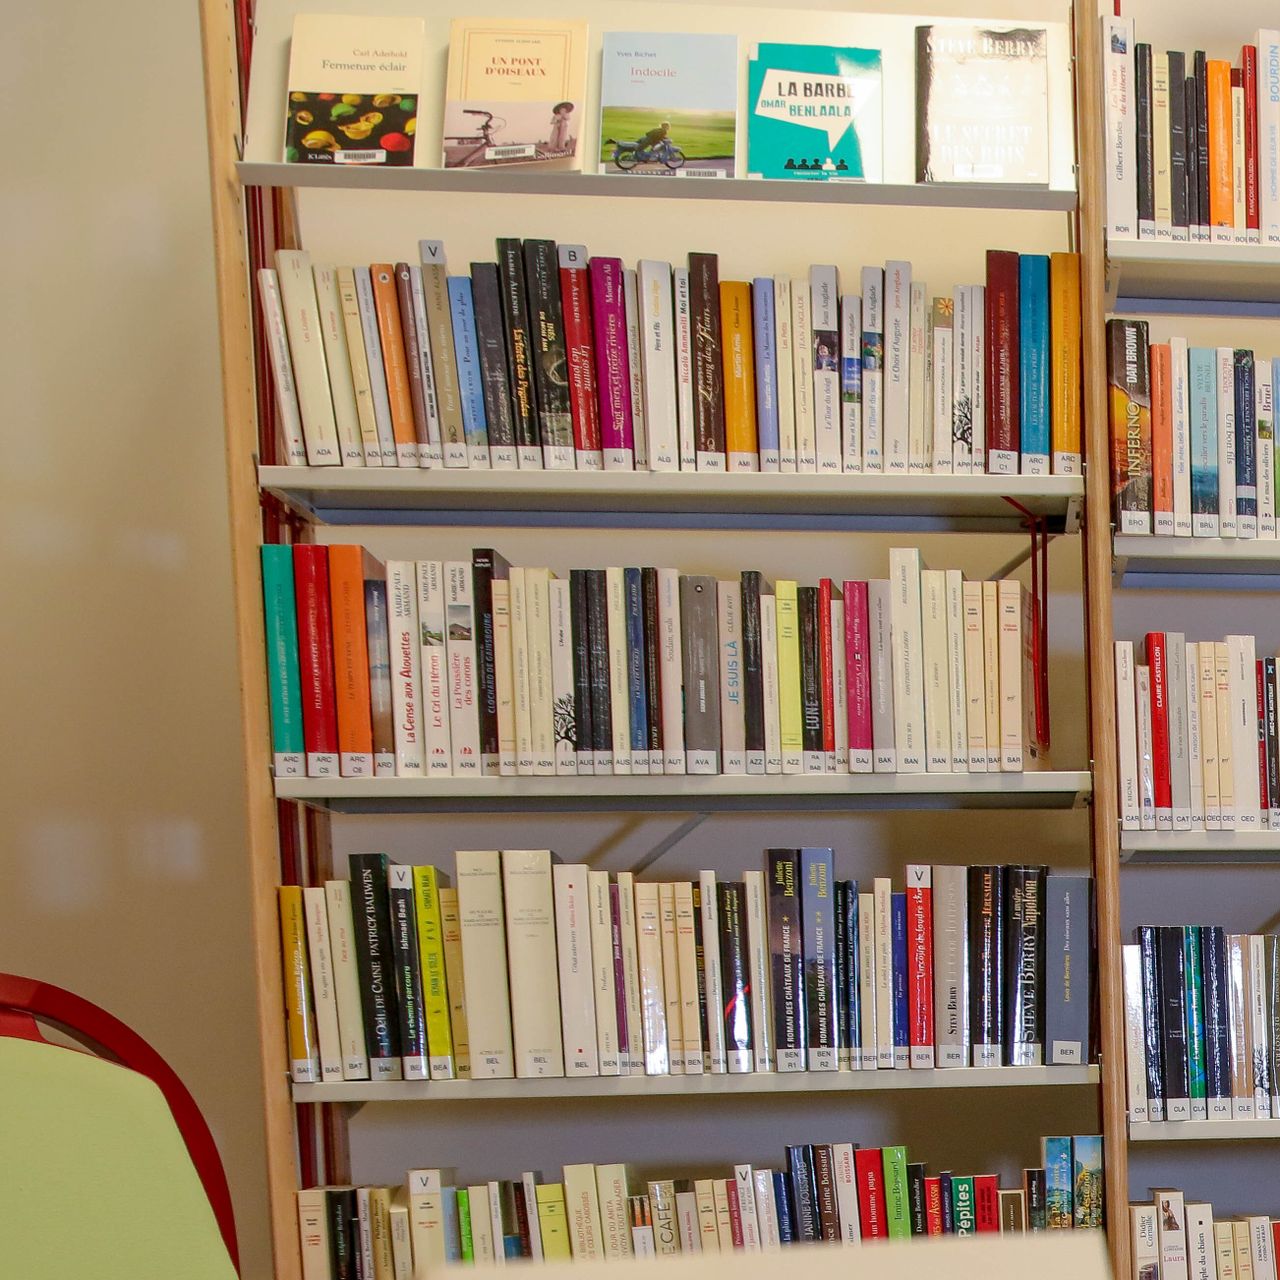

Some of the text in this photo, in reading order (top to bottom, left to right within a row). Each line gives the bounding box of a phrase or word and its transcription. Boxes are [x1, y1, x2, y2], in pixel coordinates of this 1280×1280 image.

[322, 60, 406, 71] Fermeture éclair
[492, 57, 542, 66] UN PONT
[485, 67, 546, 77] D'OISEAUX
[630, 67, 677, 77] Indocile
[1270, 44, 1280, 103] BOURDIN
[778, 82, 856, 98] LA BARBE
[761, 100, 786, 109] OMAR
[789, 104, 851, 117] BENLAALA
[1126, 328, 1137, 383] DAN BROWN
[1128, 402, 1141, 477] INFERNO
[453, 652, 461, 709] La Poussière
[730, 640, 740, 705] JE SUIS LÀ
[401, 632, 415, 744] La Cense aux Alouettes
[363, 869, 380, 957] PATRICK BAUWEN
[959, 1184, 975, 1238] Pépites
[1199, 1232, 1207, 1254] chien
[1163, 1254, 1185, 1262] Laura
[1200, 1255, 1207, 1266] du
